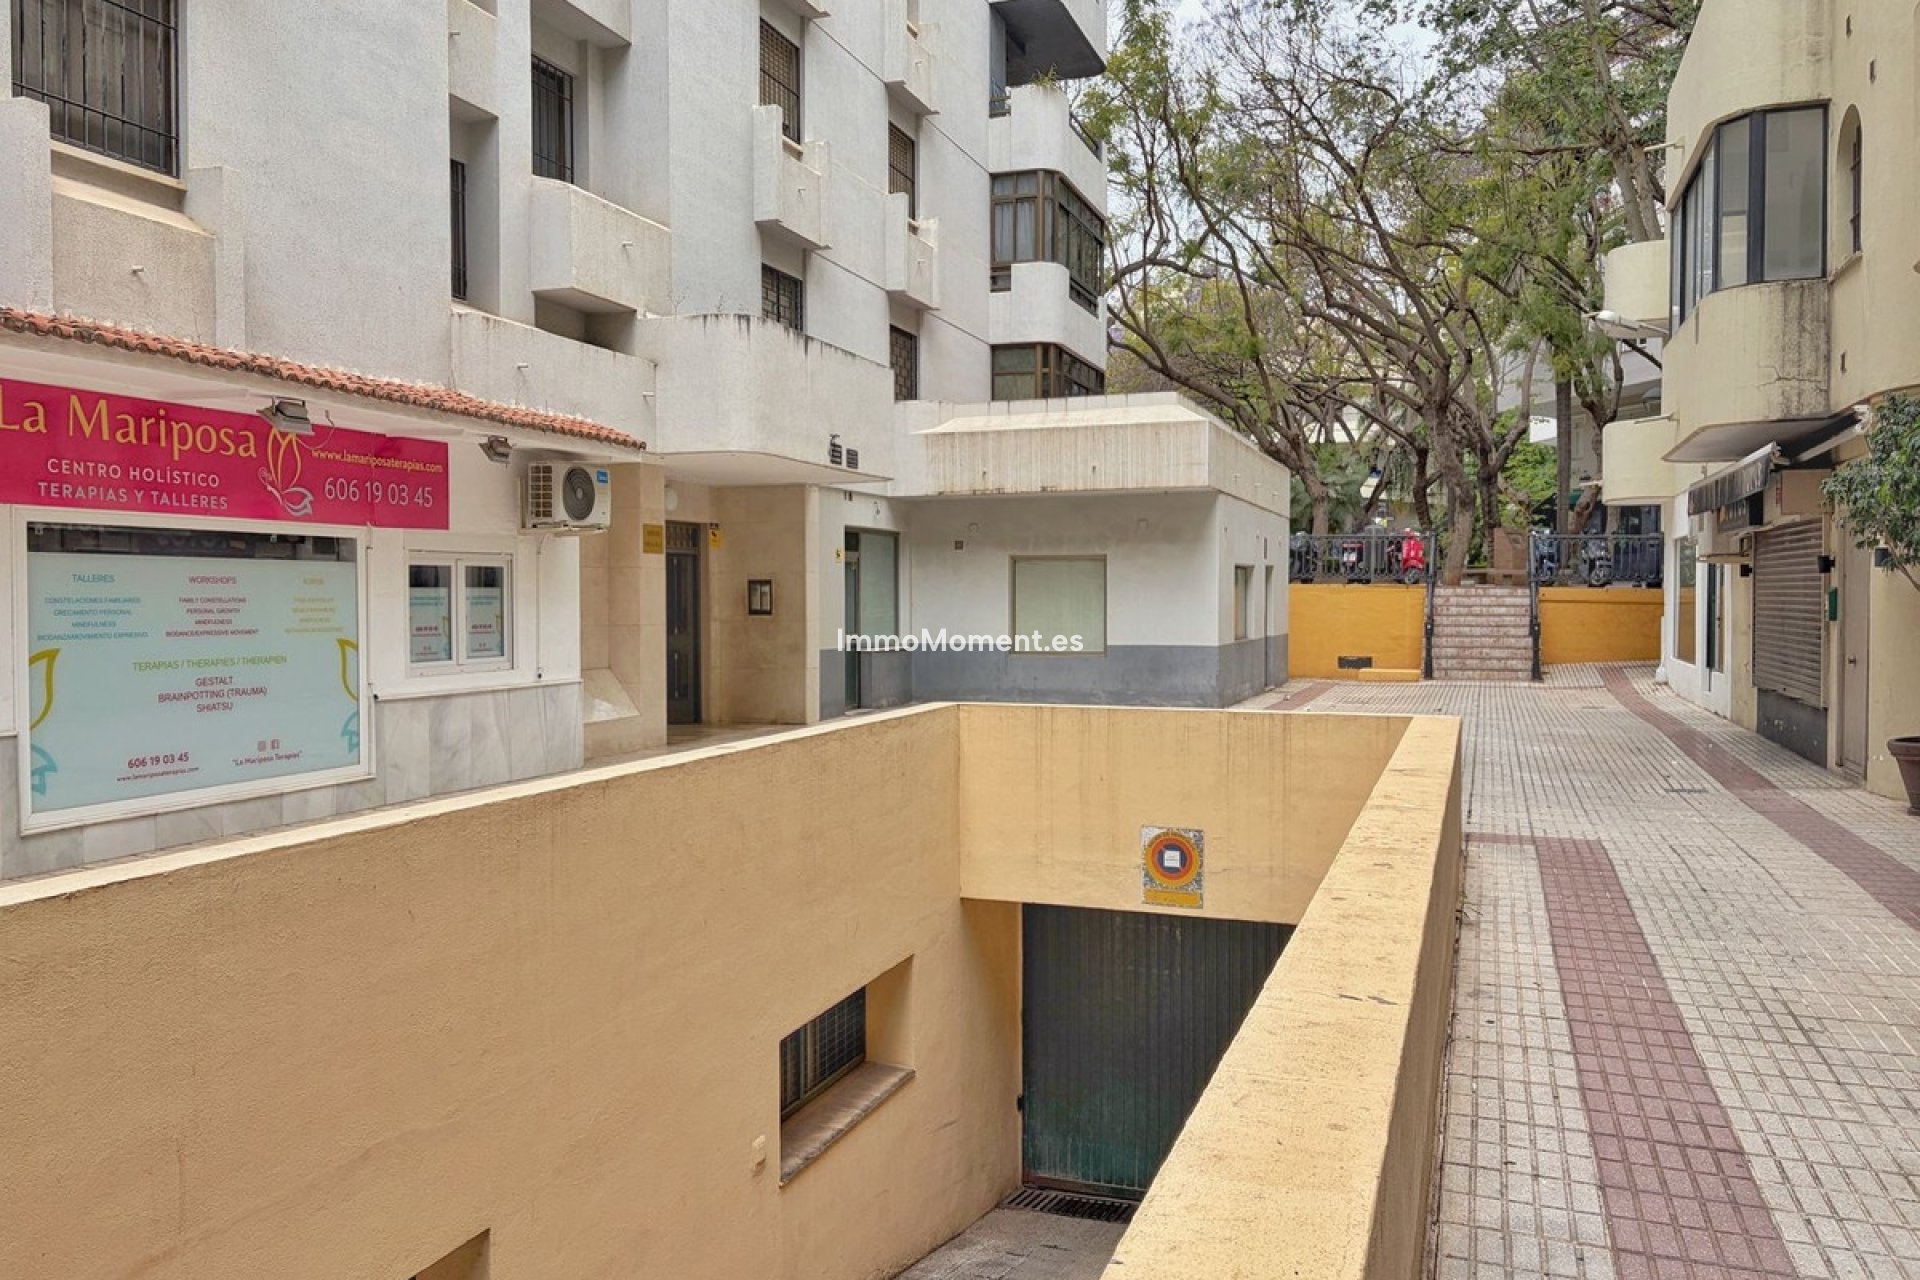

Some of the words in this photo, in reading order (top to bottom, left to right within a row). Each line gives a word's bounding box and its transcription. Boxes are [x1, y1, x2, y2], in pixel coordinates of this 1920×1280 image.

[0, 384, 48, 434] La
[68, 394, 257, 462] Mariposa
[311, 448, 443, 473] www.lamariposaterapias.com
[47, 458, 122, 479] CENTRO
[129, 466, 220, 488] HOLÍSTICO
[38, 482, 128, 503] TERAPIAS
[134, 490, 145, 504] Y
[151, 490, 229, 510] TALLERES
[324, 477, 360, 502] 606
[364, 481, 382, 503] 19
[388, 482, 409, 506] 03
[413, 486, 433, 508] 45
[71, 573, 115, 583] TALLERES
[188, 575, 238, 585] WORKSHOPS
[132, 661, 180, 672] TERAPIAS
[187, 657, 235, 669] THERAPIES
[242, 655, 288, 666] THERAPIEN
[195, 676, 234, 687] GESTALT
[226, 686, 268, 700] (TRAUMA)
[196, 701, 234, 713] SHIATSU
[128, 758, 148, 769] 606
[150, 756, 161, 766] 19
[162, 754, 176, 765] 03
[177, 751, 190, 763] 45
